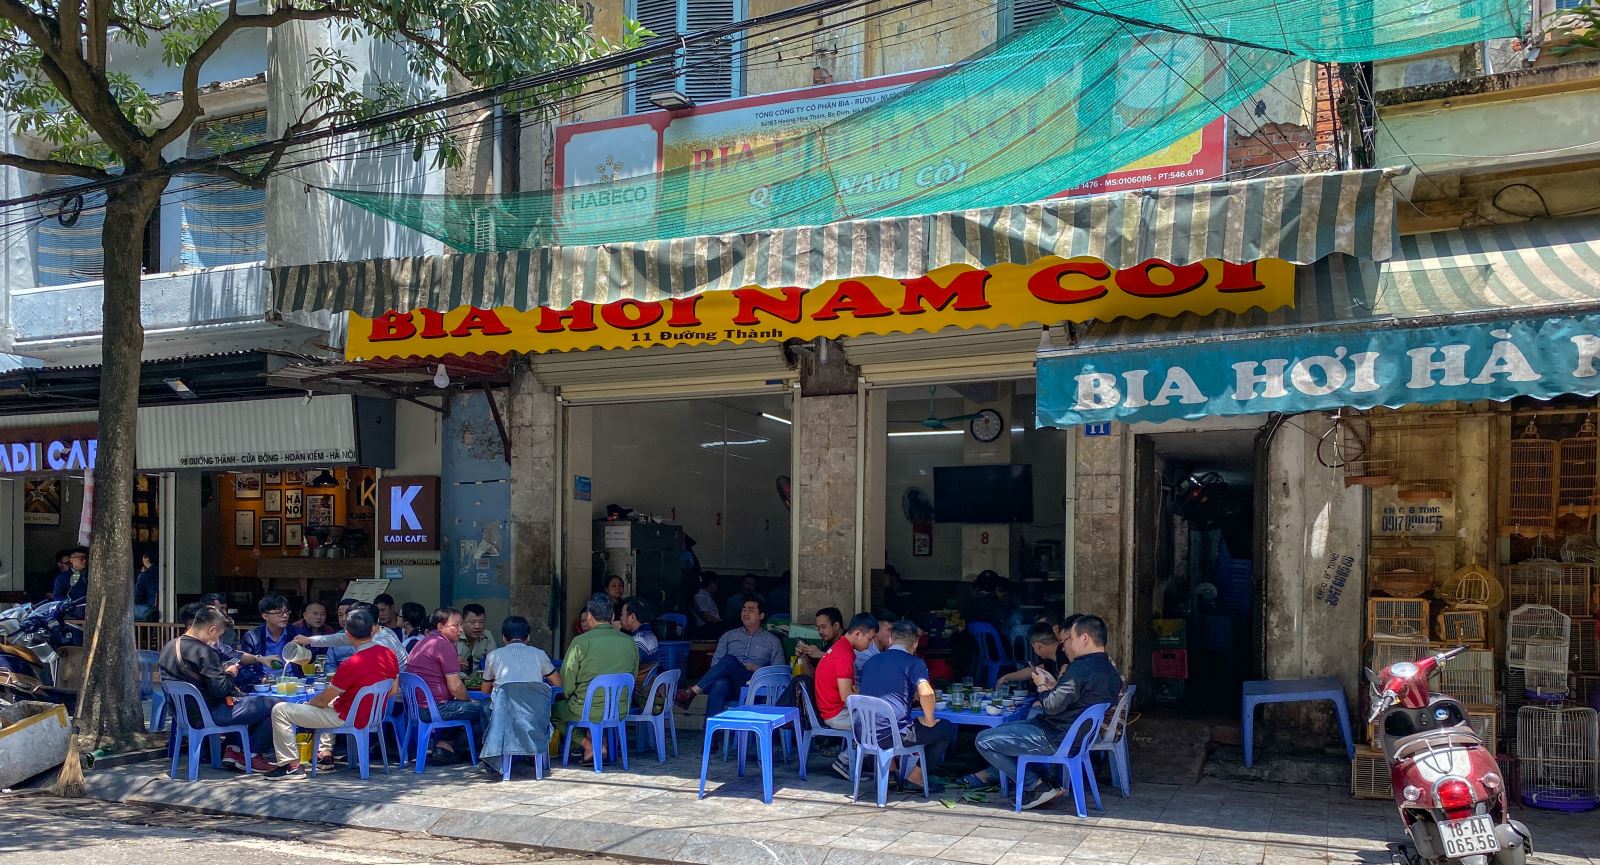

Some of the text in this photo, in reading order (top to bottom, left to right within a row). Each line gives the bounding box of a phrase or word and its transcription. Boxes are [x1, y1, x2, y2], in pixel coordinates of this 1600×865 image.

[838, 100, 850, 108] BIA
[1104, 174, 1152, 187] MS:0106086
[571, 186, 647, 209] HABECO
[368, 305, 512, 342] BIA
[732, 268, 992, 326] NAM
[632, 326, 783, 343] 11 Đường Thành
[1072, 365, 1208, 411] BIA
[1231, 346, 1381, 400] HƠI
[47, 439, 98, 471] CAF
[391, 485, 423, 531] K
[384, 535, 428, 543] KADI CAFE
[981, 532, 989, 544] 8
[1448, 819, 1487, 838] 18-AA
[1446, 834, 1496, 855] 065.56
